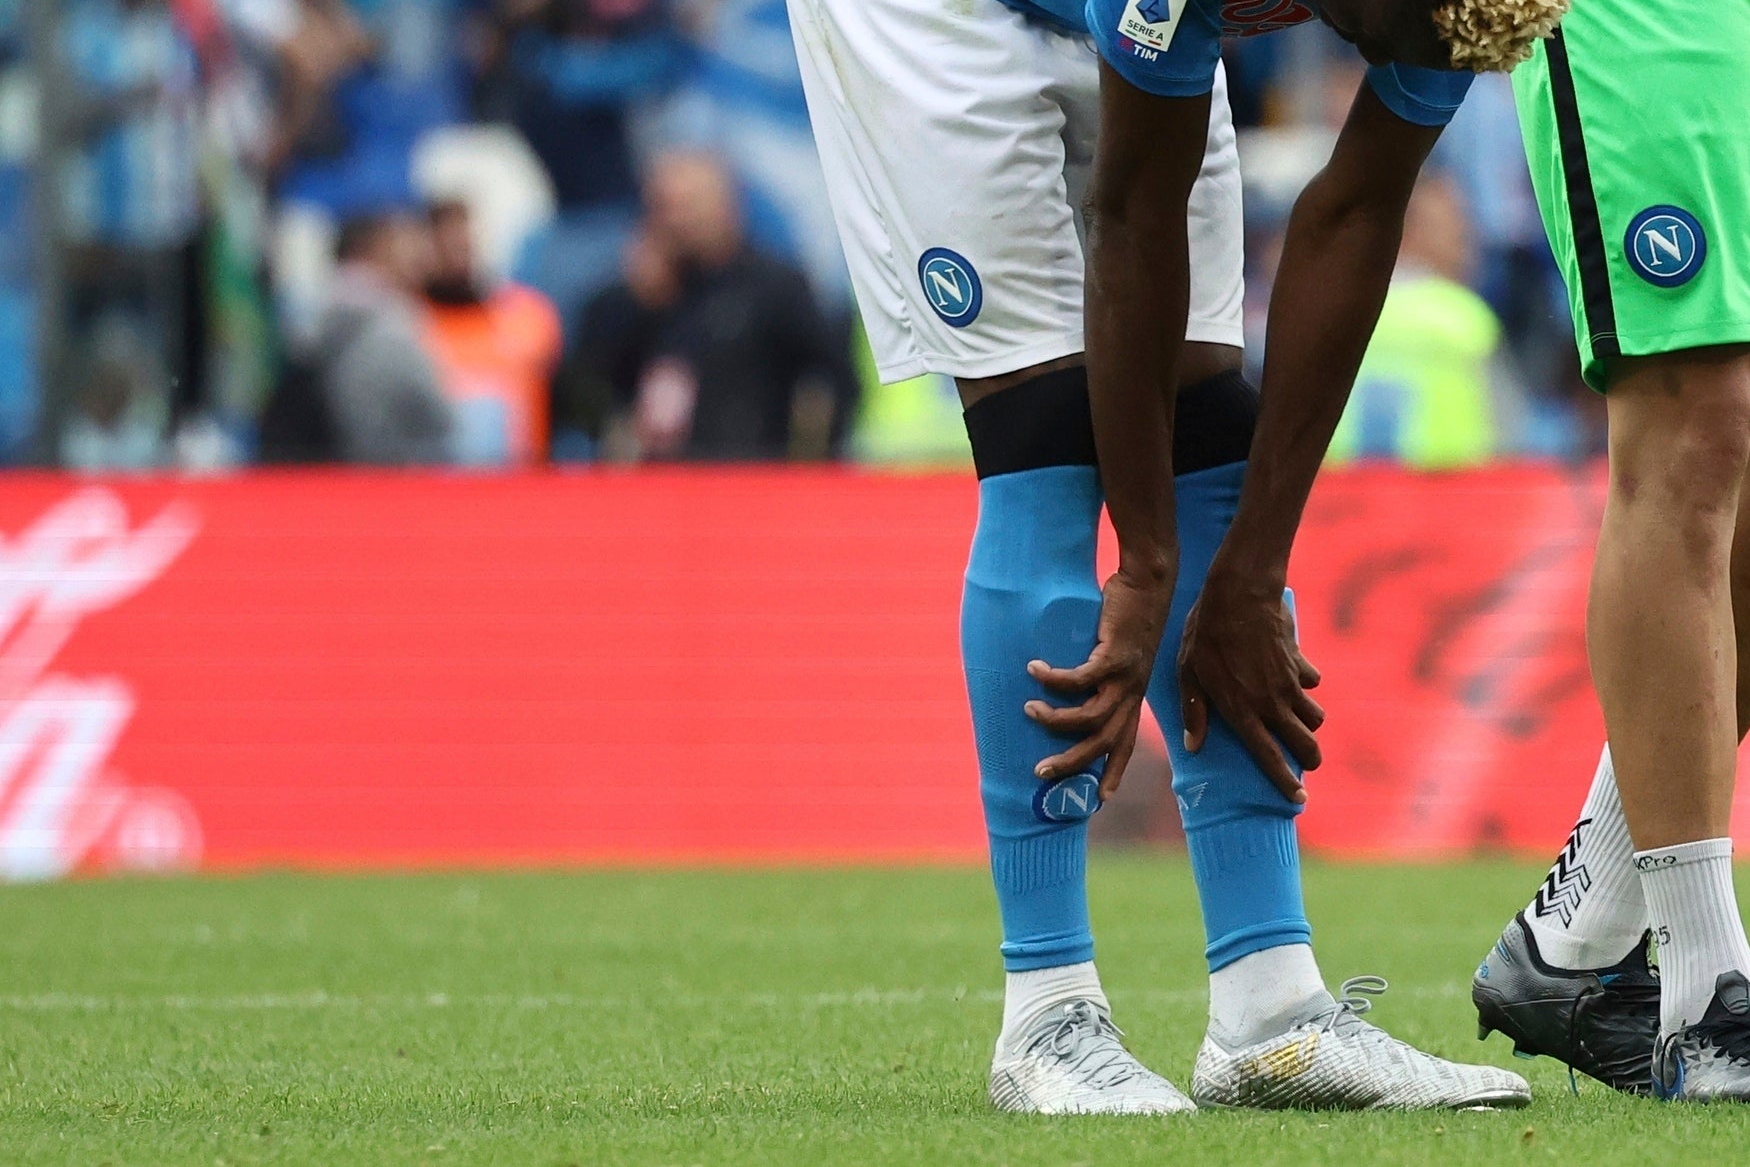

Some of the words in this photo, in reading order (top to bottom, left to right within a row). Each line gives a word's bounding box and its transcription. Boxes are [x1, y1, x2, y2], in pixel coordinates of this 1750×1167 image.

[1127, 19, 1154, 38] SERIE
[1156, 31, 1164, 42] A
[1133, 43, 1159, 62] TIM
[1643, 225, 1682, 266] N
[927, 268, 963, 306] N
[1061, 784, 1090, 815] N
